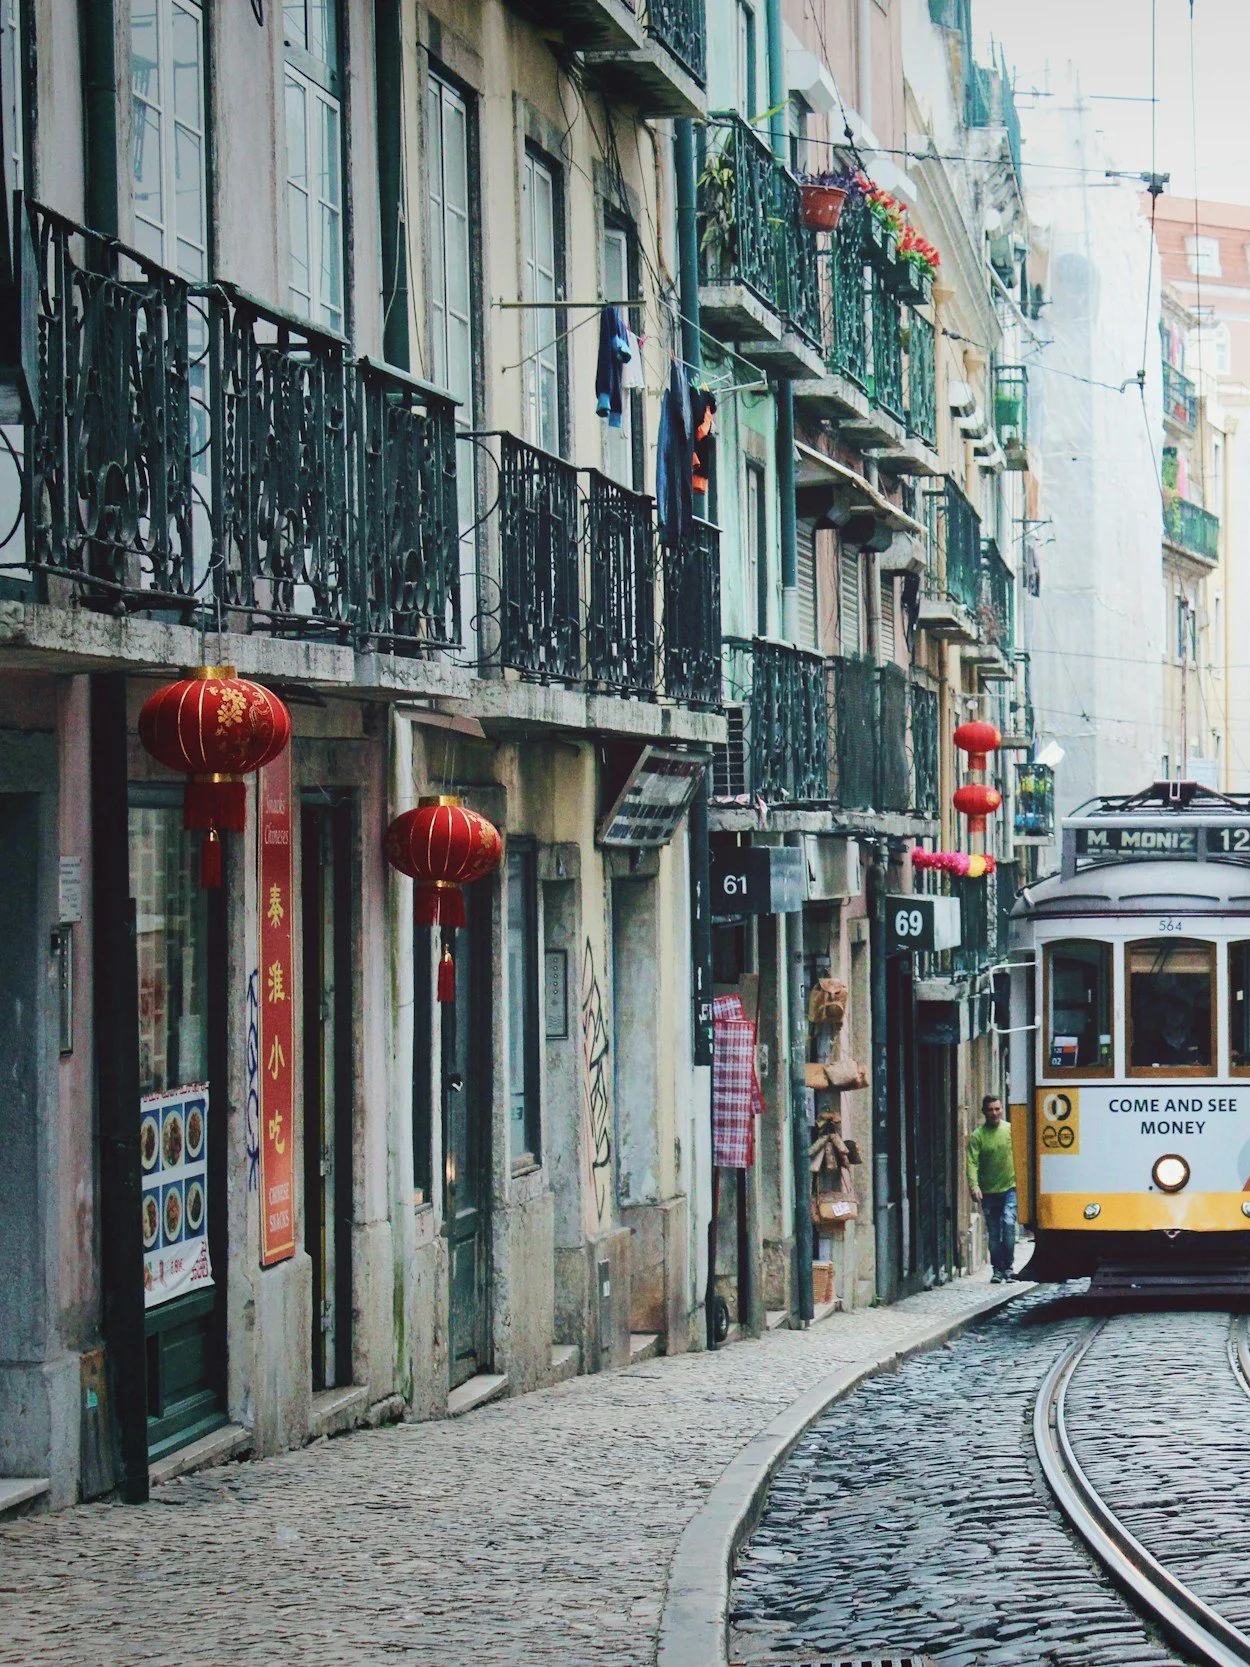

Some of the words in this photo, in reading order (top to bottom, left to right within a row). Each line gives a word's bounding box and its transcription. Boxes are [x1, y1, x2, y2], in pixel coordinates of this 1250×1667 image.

[1087, 830, 1110, 846] M.
[1121, 832, 1196, 849] MONIZ
[1220, 828, 1250, 851] 12
[723, 875, 748, 895] 61
[895, 910, 923, 936] 69
[1158, 920, 1182, 931] 564
[1109, 1099, 1160, 1113] COME
[1164, 1099, 1203, 1112] AND
[1208, 1098, 1237, 1112] SEE
[1140, 1121, 1206, 1135] MONEY
